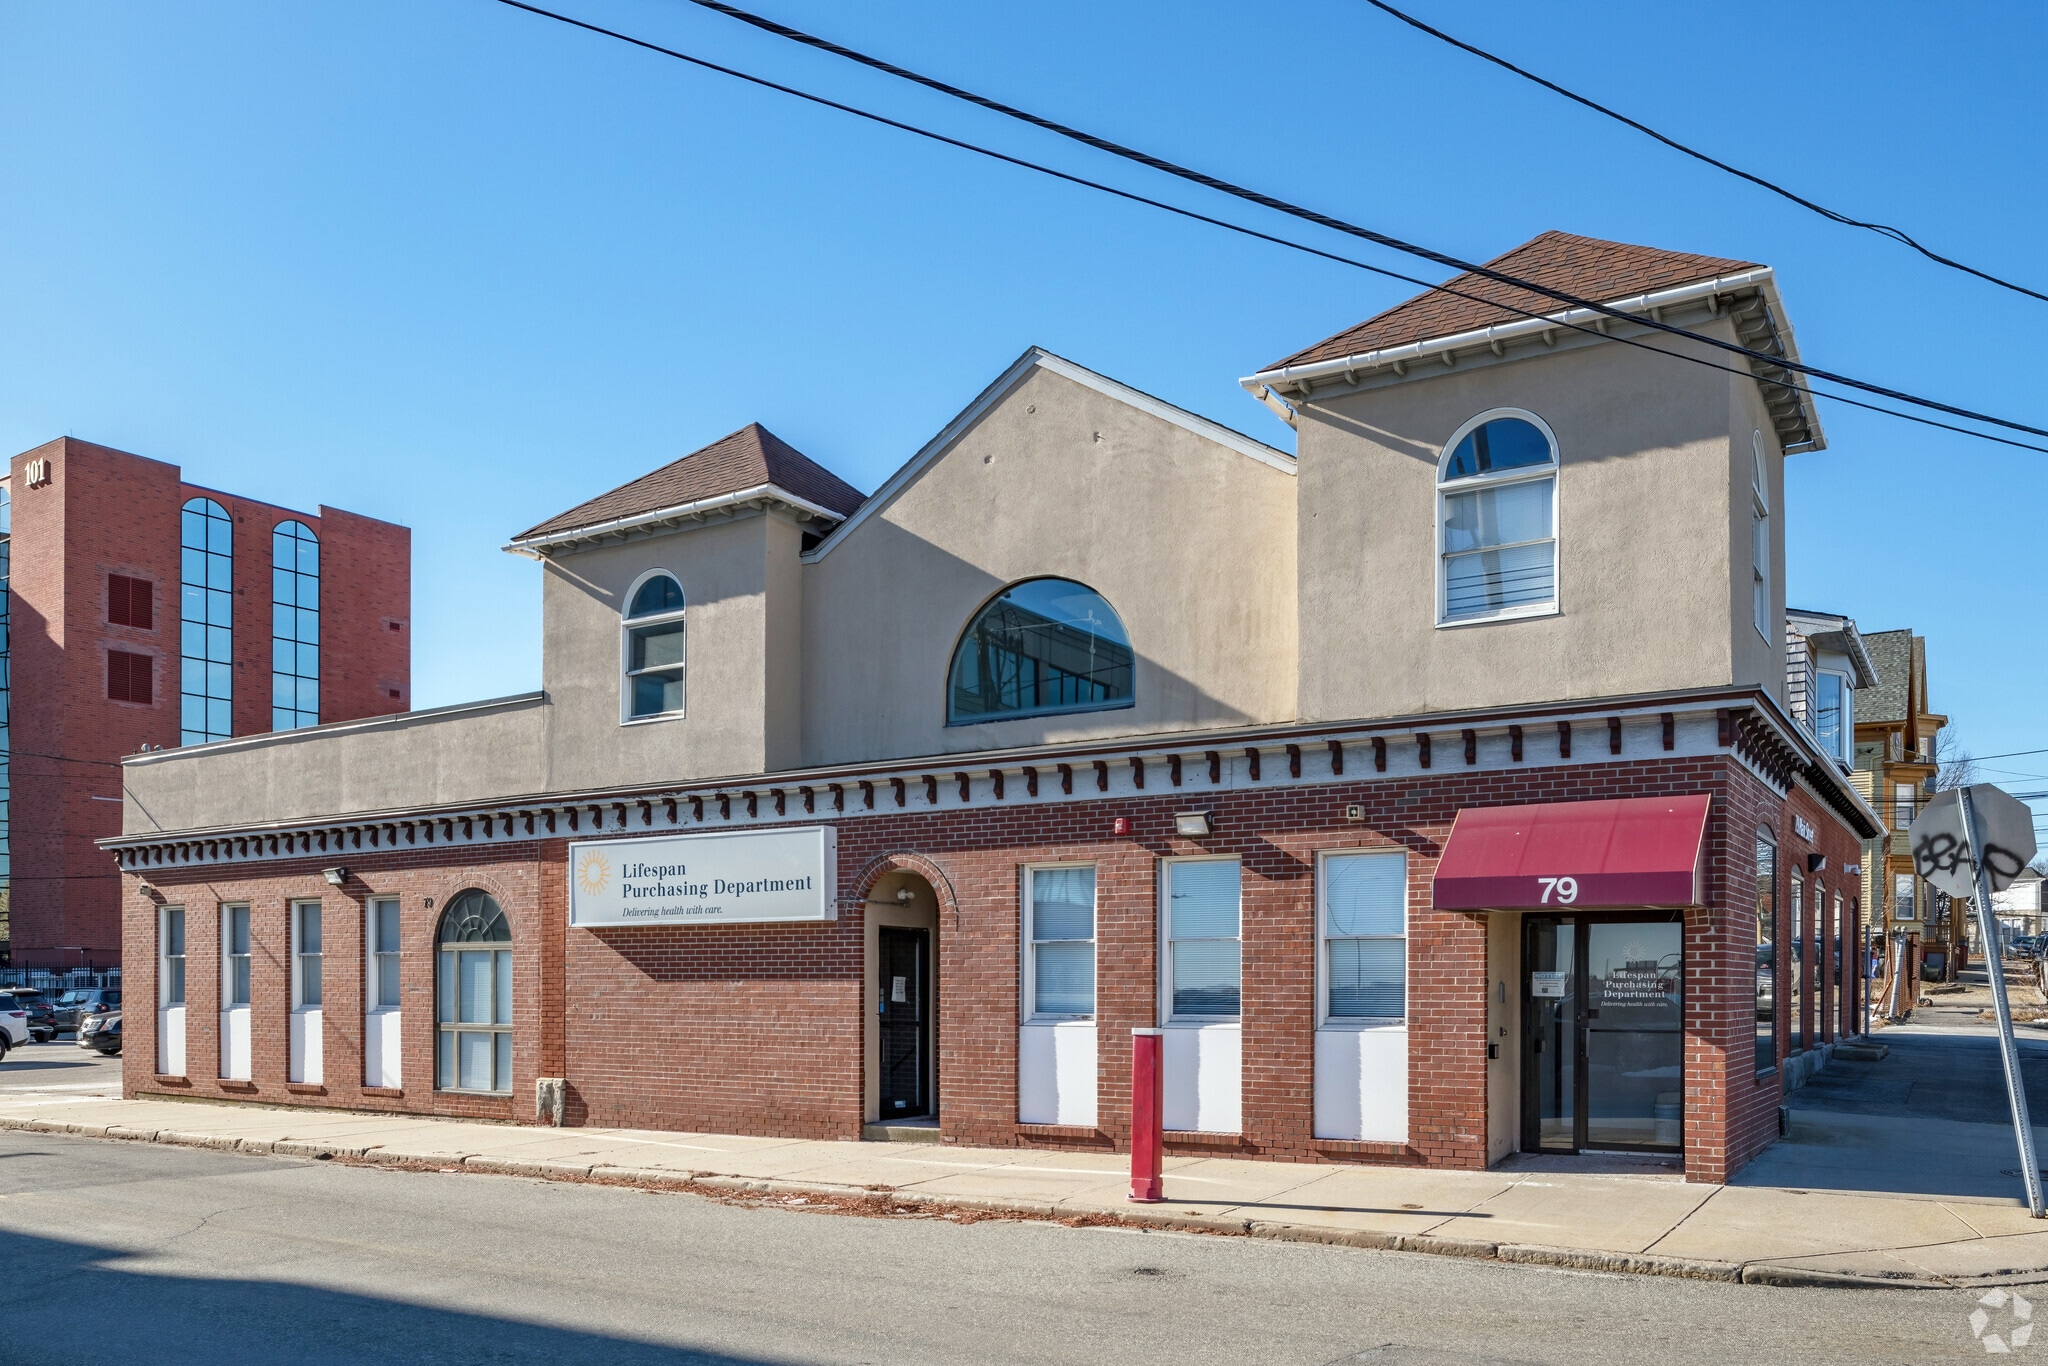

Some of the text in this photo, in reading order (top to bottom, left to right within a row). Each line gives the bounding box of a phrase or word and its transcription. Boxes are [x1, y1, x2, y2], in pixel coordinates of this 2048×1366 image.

[24, 457, 45, 486] 101
[622, 863, 686, 880] Lifespan
[622, 876, 813, 899] Purchasing Department
[1538, 877, 1578, 904] 79
[622, 904, 723, 918] Delivering health with care.
[1612, 971, 1657, 981] Lifespan
[1605, 980, 1664, 990] Purchasing
[1603, 989, 1666, 1000] Department
